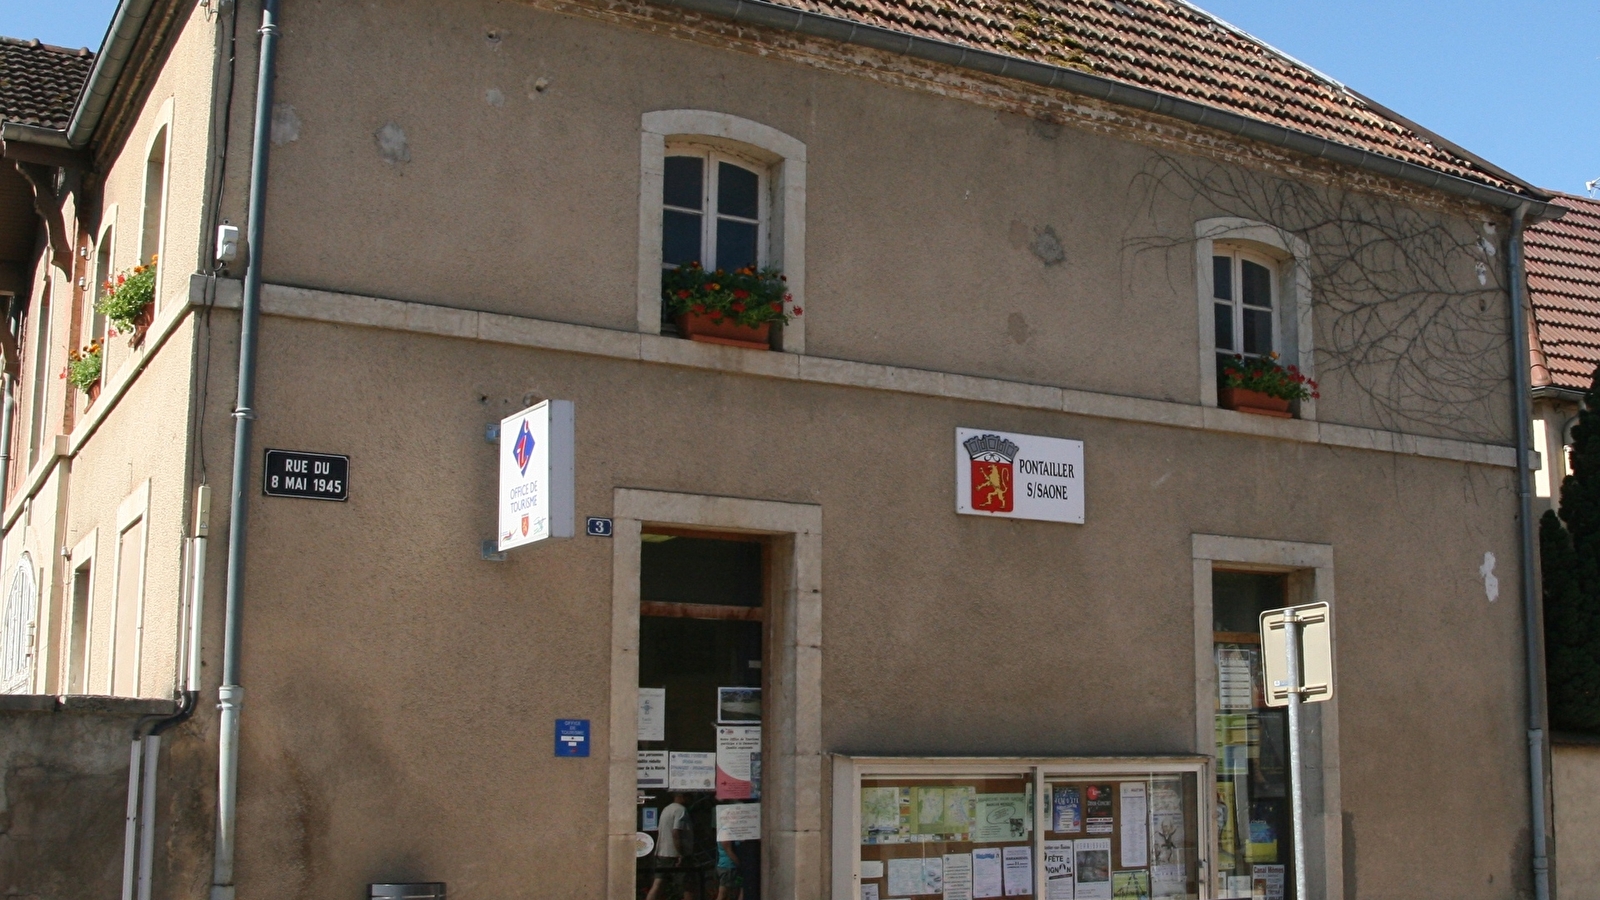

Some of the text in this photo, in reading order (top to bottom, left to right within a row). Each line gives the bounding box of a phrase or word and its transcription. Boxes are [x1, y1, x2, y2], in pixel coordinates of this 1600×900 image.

[285, 459, 330, 475] RUE DU
[1019, 459, 1075, 479] PONTAILLER
[271, 475, 341, 493] 8 MAI 1945
[510, 480, 538, 500] OFFICE DE
[1026, 481, 1068, 500] S/SAONE
[510, 494, 538, 514] TOURISME
[594, 520, 605, 533] 3
[1254, 866, 1267, 874] Canal
